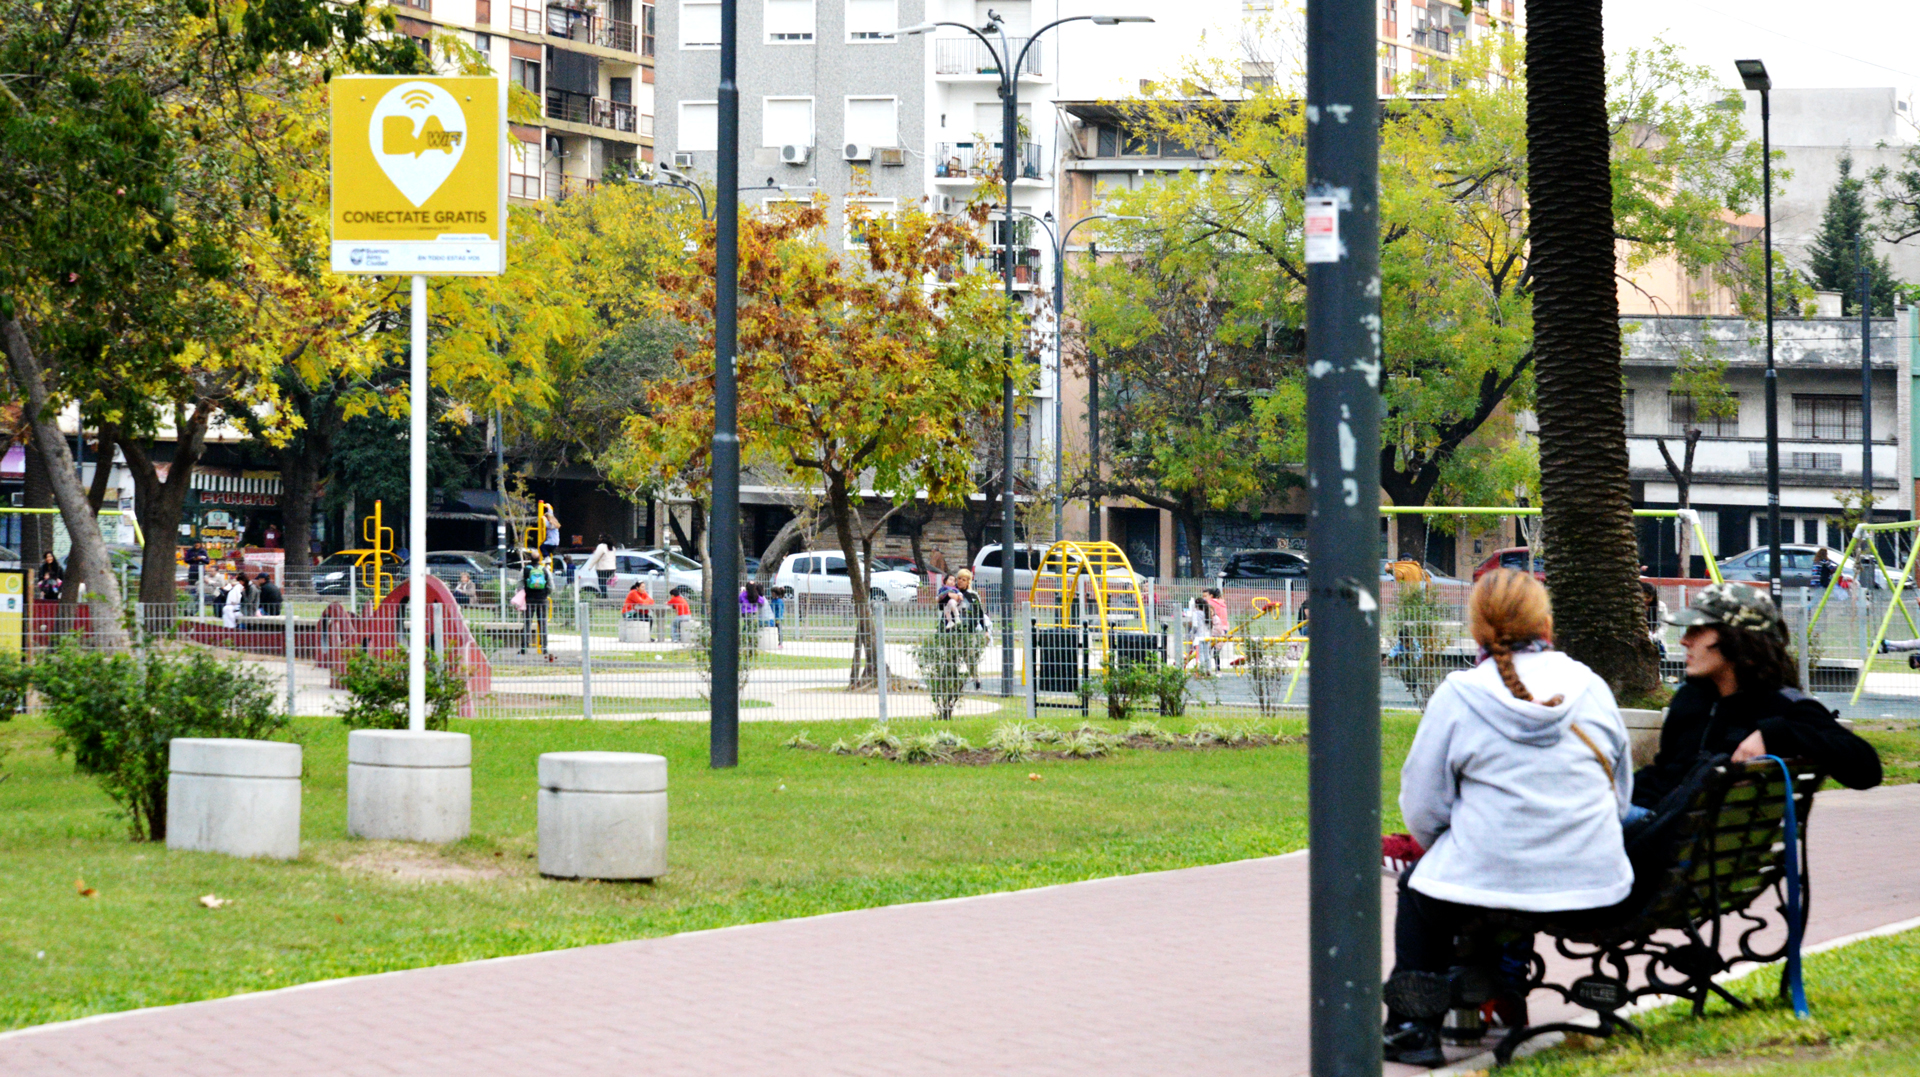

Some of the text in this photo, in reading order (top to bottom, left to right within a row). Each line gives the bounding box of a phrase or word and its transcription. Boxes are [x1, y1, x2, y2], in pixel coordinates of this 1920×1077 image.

[343, 211, 487, 223] CONECTATE GRATIS
[200, 492, 276, 506] Fruteria
